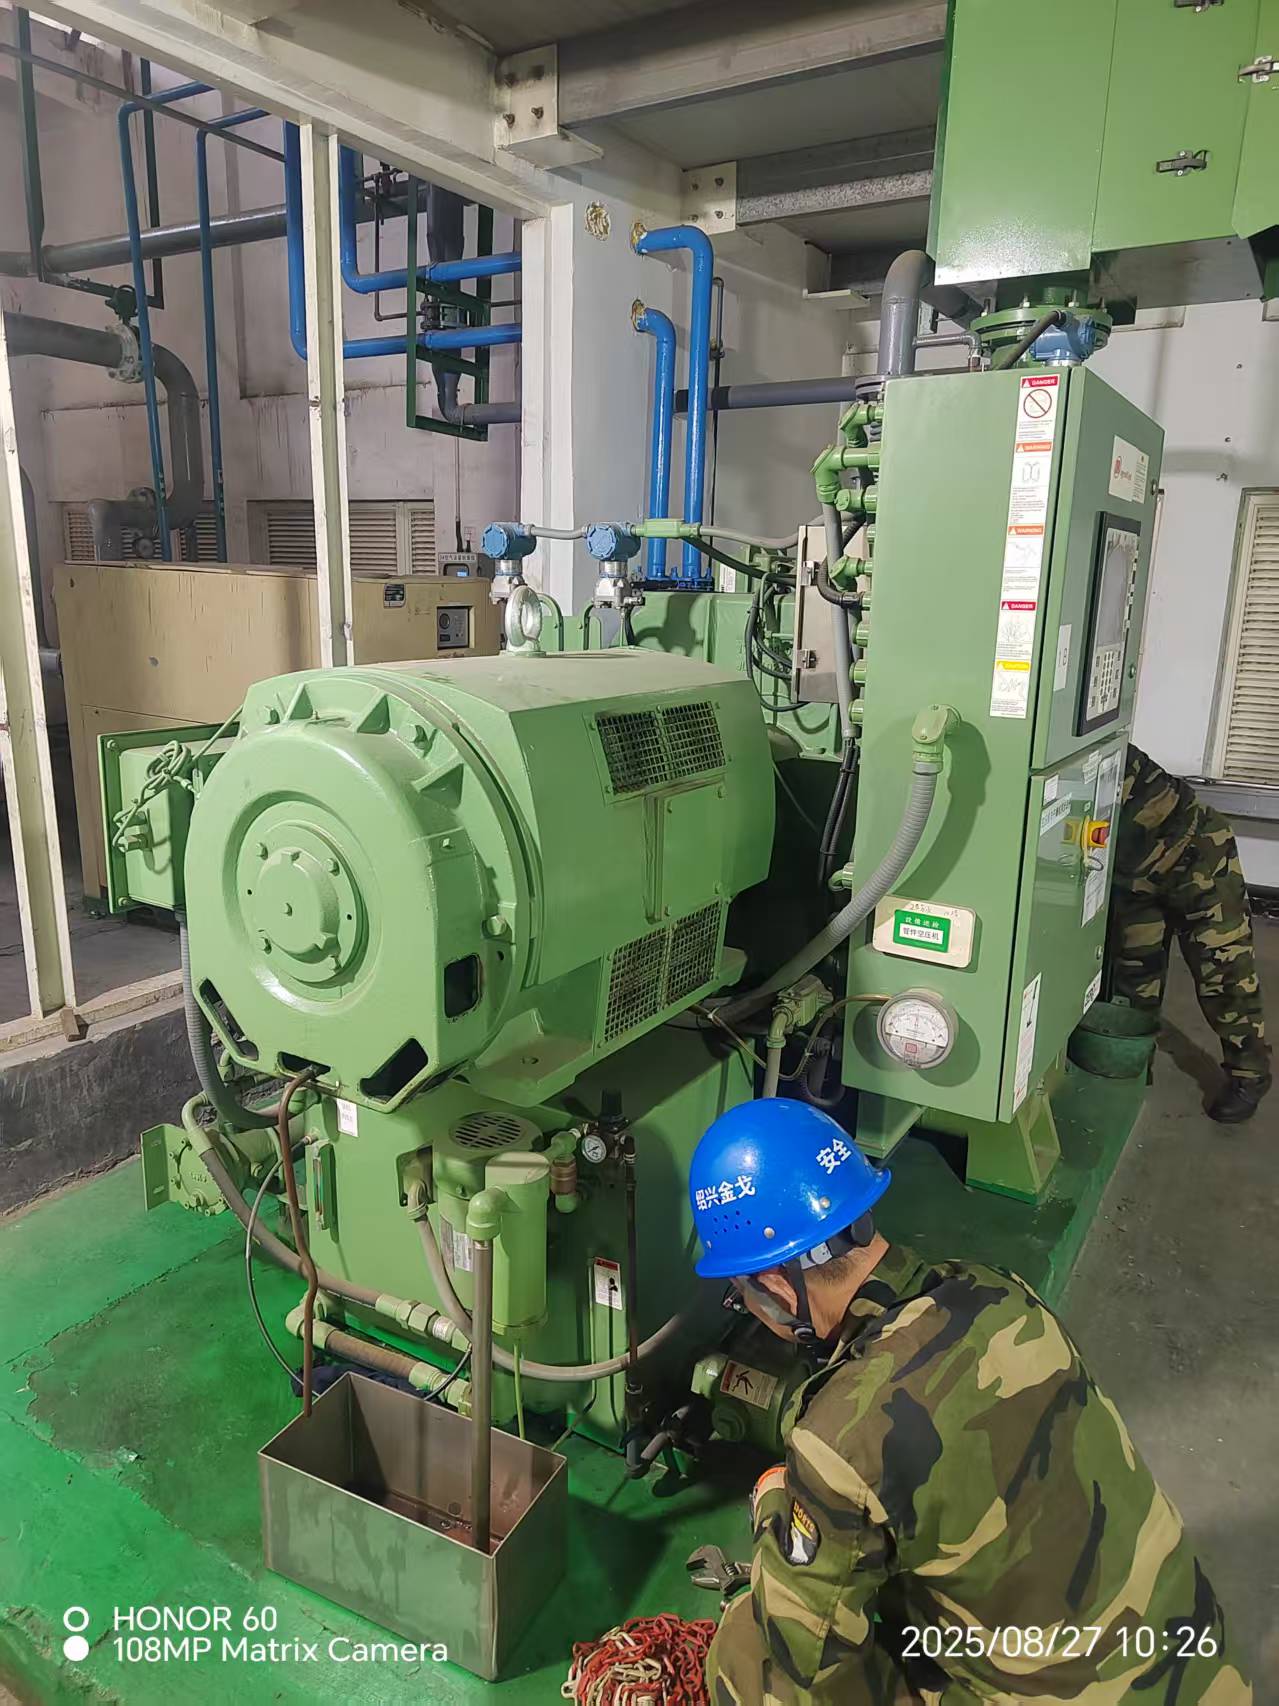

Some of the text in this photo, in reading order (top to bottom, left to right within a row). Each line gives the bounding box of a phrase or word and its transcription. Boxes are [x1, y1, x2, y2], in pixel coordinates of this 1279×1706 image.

[1031, 378, 1056, 386] DANGER
[1010, 602, 1034, 610] DANGER
[816, 1138, 852, 1175] 安全
